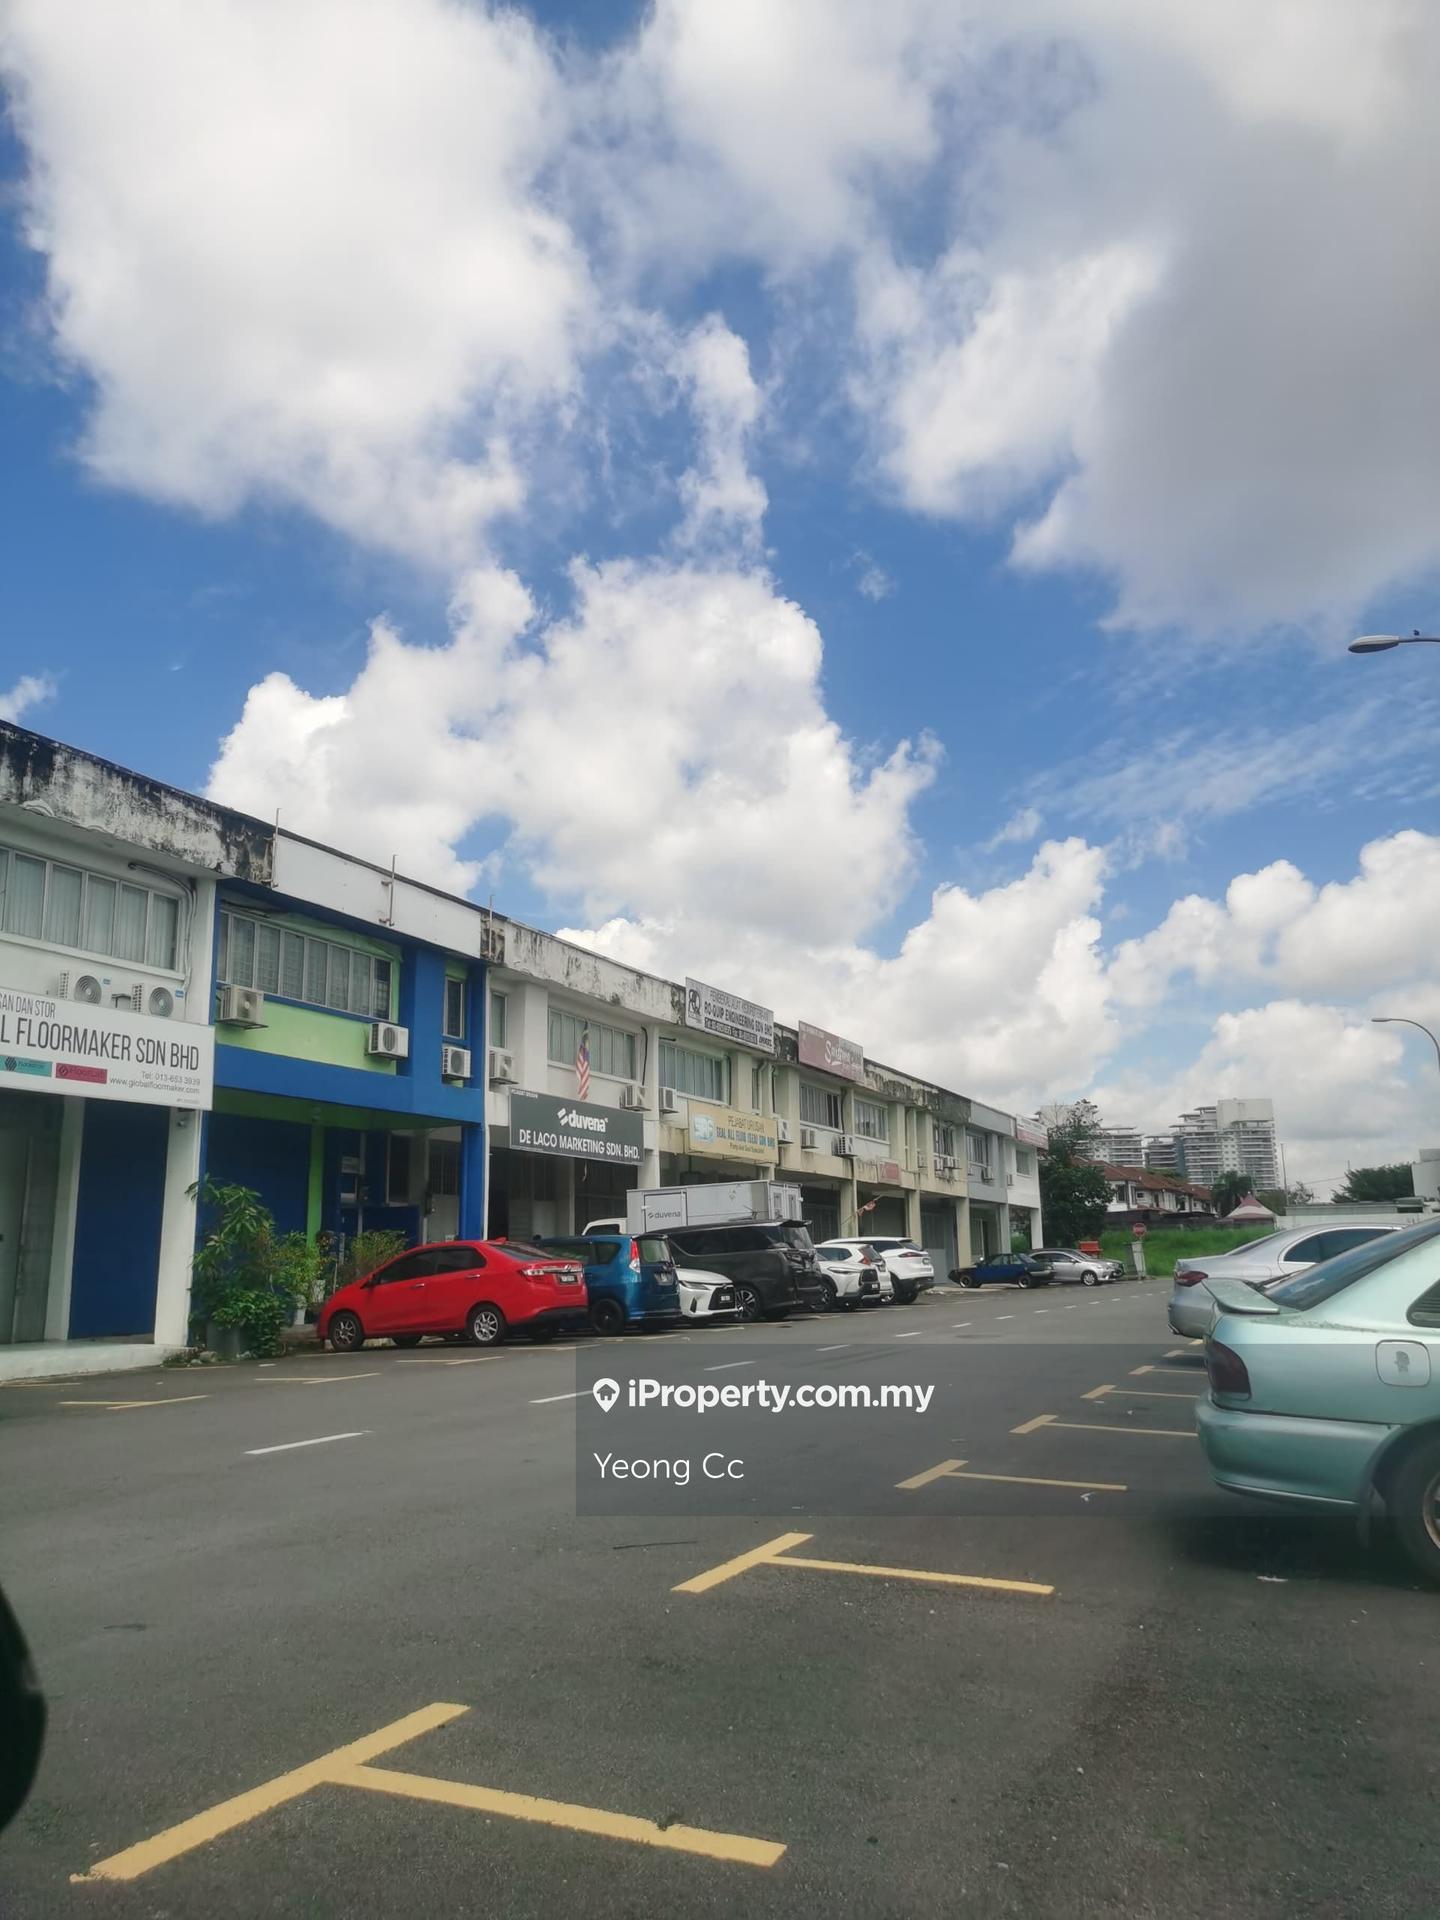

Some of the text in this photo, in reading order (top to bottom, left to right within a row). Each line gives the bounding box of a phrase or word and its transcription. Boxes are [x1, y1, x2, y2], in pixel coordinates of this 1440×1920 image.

[16, 997, 34, 1015] DAN
[34, 1000, 56, 1019] STOR
[725, 1009, 755, 1030] ENGINEERING
[16, 1017, 131, 1061] FLOORMAKER
[135, 1038, 166, 1066] SDN
[170, 1043, 199, 1071] BHD
[109, 1077, 200, 1094] www.globalfloormaker.com
[141, 1071, 153, 1080] Tel:
[569, 1109, 606, 1133] duvena
[519, 1128, 640, 1159] DE LACO MARKETING SDN. BHD.
[654, 1210, 681, 1219] duvena
